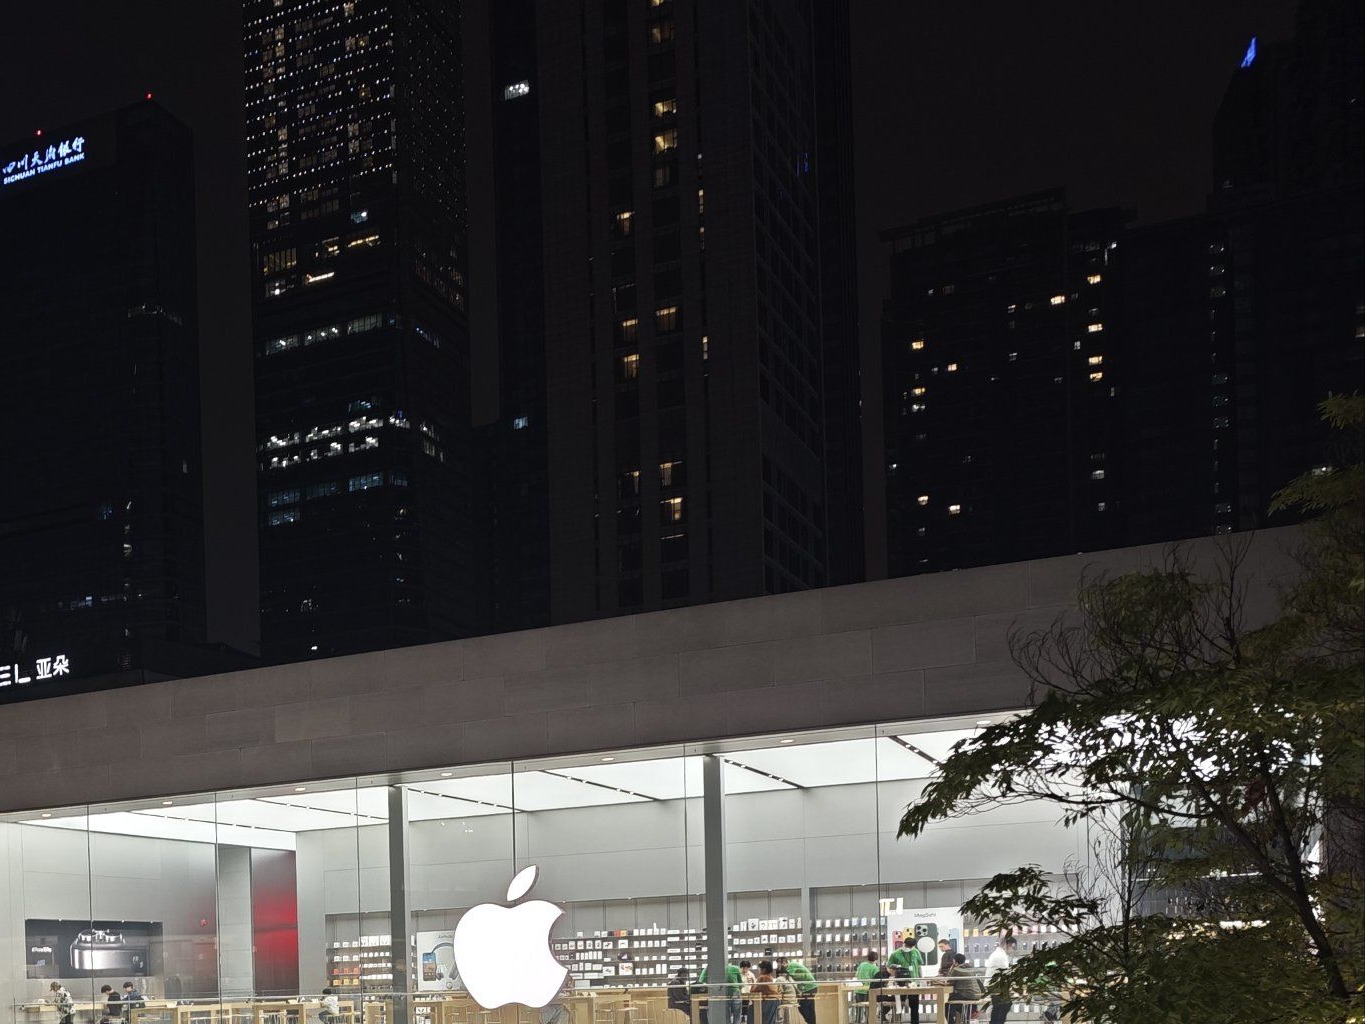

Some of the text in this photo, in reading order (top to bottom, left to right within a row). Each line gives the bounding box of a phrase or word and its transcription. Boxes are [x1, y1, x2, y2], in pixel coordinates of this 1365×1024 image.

[3, 152, 85, 185] SICHUAN TIANFU BANK
[36, 655, 70, 680] 亚朵
